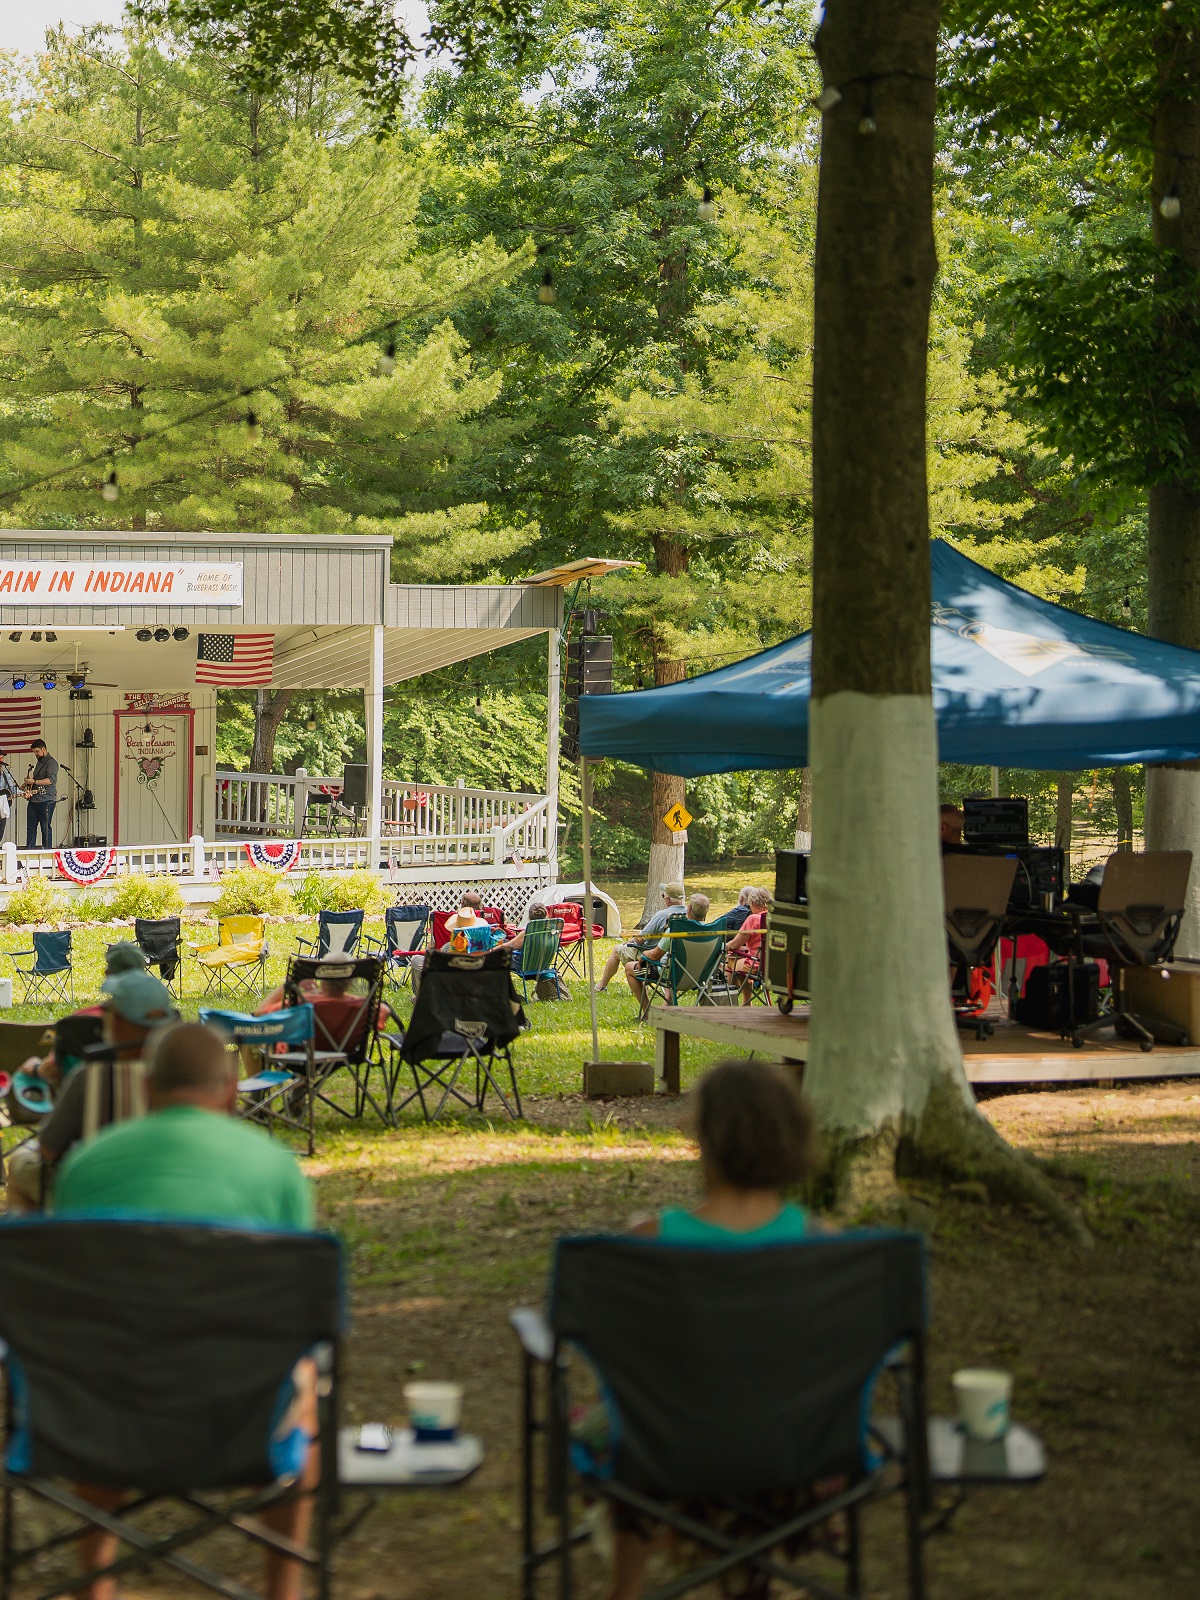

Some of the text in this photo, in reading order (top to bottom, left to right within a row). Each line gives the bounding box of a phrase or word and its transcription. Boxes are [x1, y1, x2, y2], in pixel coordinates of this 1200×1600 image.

[48, 571, 75, 593] IN
[197, 573, 233, 582] HOME OF
[186, 583, 238, 592] BLUEGRASS MUSIC
[125, 735, 144, 748] Bean
